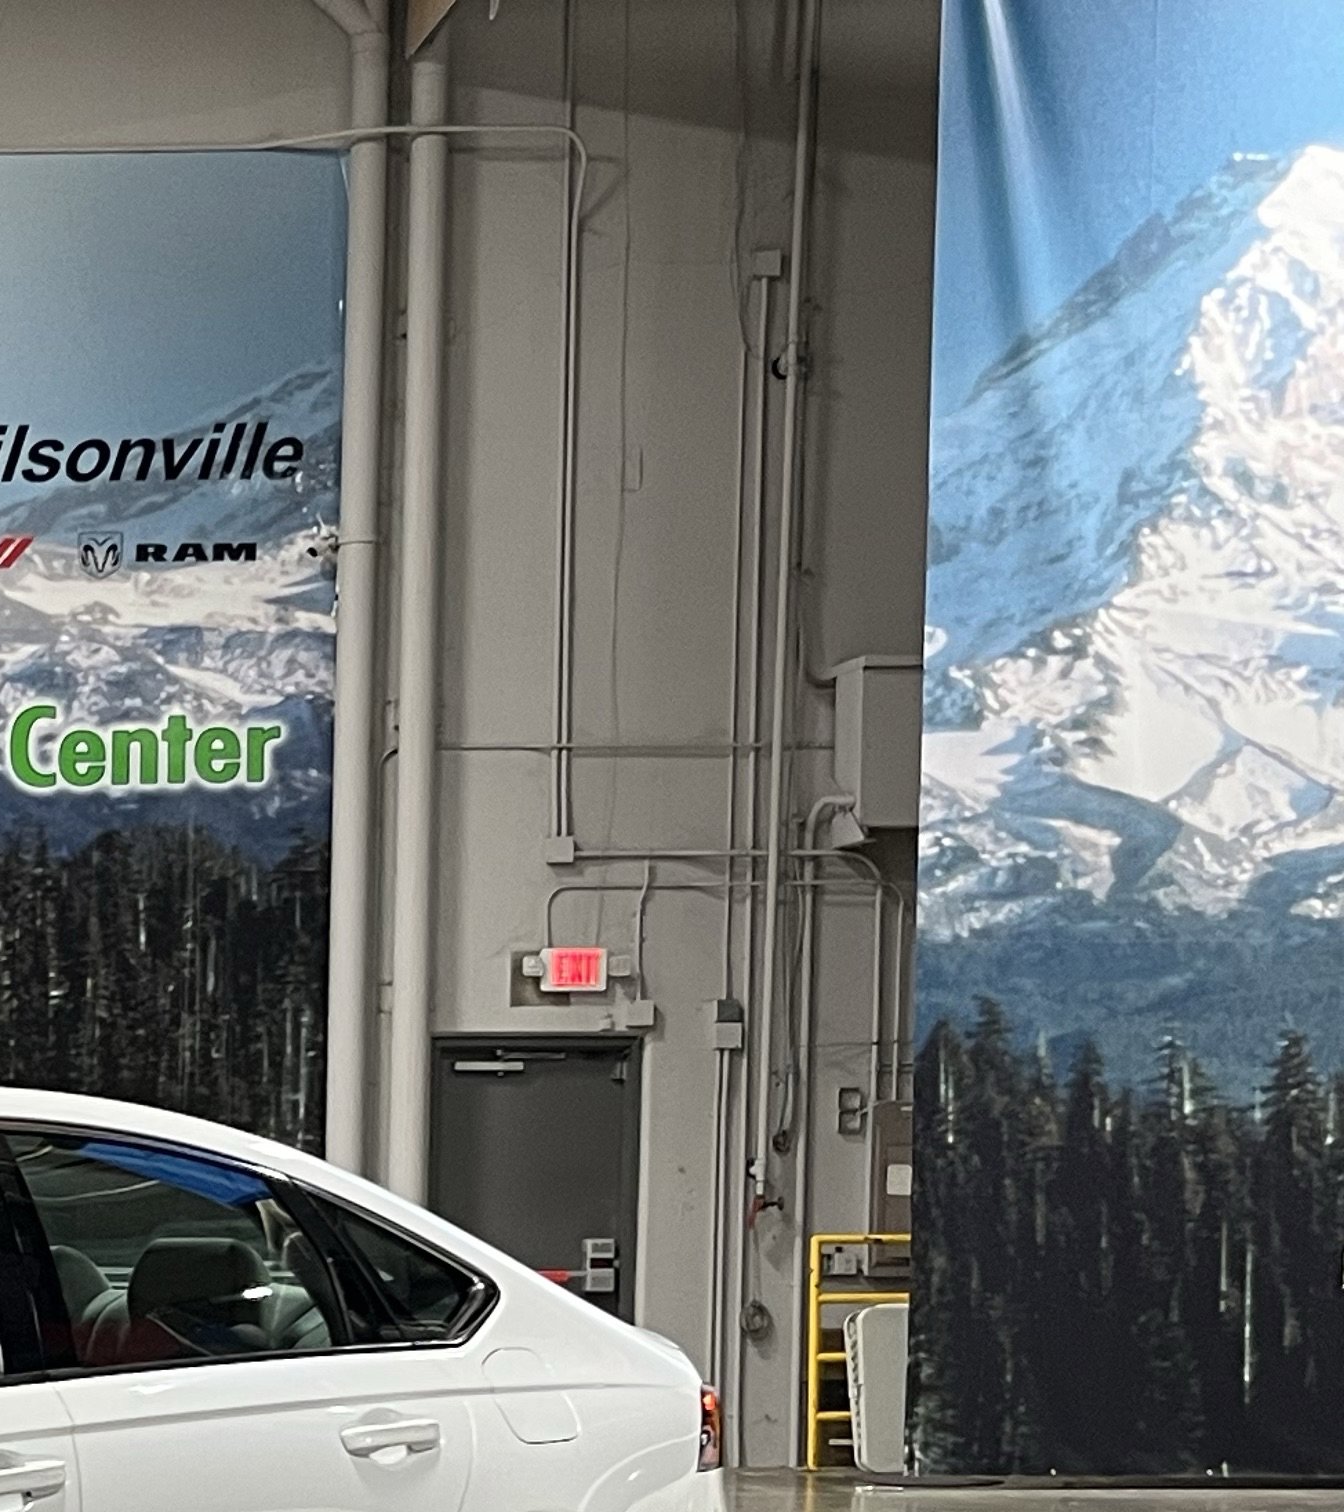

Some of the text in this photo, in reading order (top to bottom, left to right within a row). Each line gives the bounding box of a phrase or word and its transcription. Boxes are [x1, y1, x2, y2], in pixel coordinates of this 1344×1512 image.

[134, 542, 258, 562] RAM
[11, 704, 282, 788] Center
[557, 953, 600, 983] EXIT
